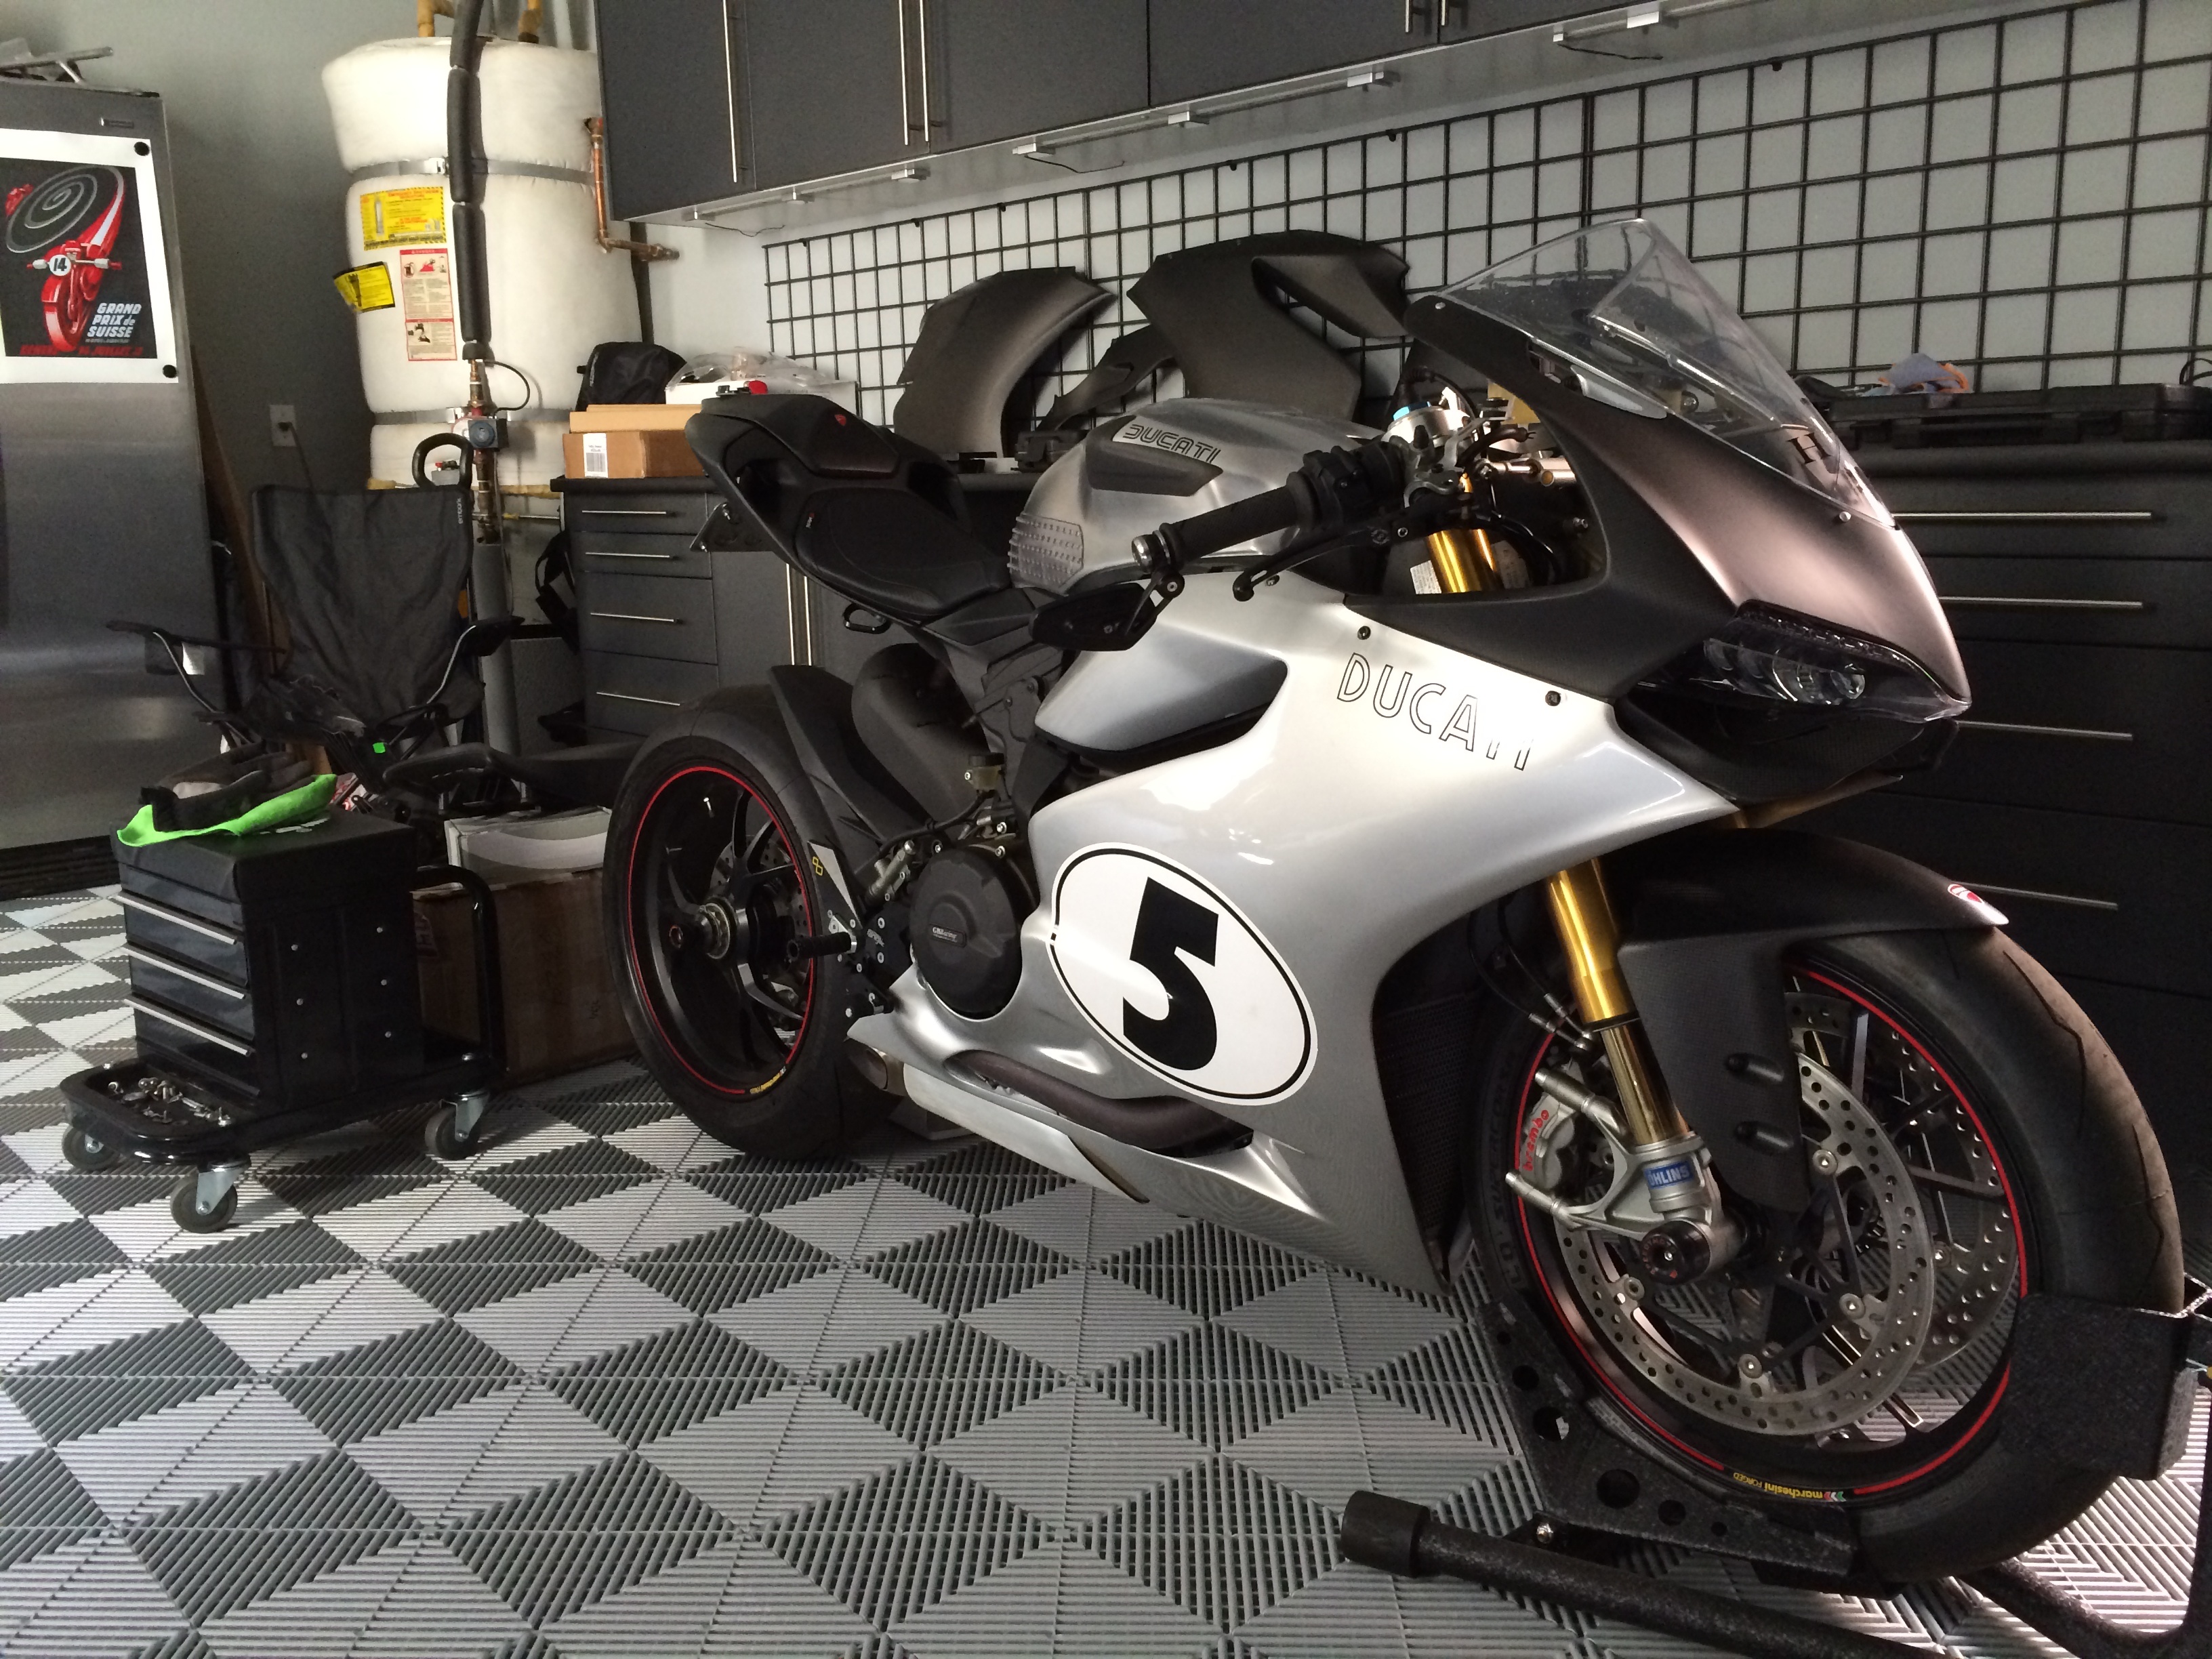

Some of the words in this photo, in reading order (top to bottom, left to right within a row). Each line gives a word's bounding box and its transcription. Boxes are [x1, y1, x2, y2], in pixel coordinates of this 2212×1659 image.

[54, 258, 68, 272] 14
[97, 302, 142, 314] GRAND
[91, 314, 125, 325] PRIX
[123, 314, 136, 326] de
[87, 325, 134, 338] SUISSE
[1122, 423, 1222, 464] DUCATI
[1122, 876, 1219, 1071] 5
[1522, 1109, 1550, 1172] brembo
[1733, 1472, 1762, 1488] FORGED
[1764, 1481, 1823, 1499] marchesini
